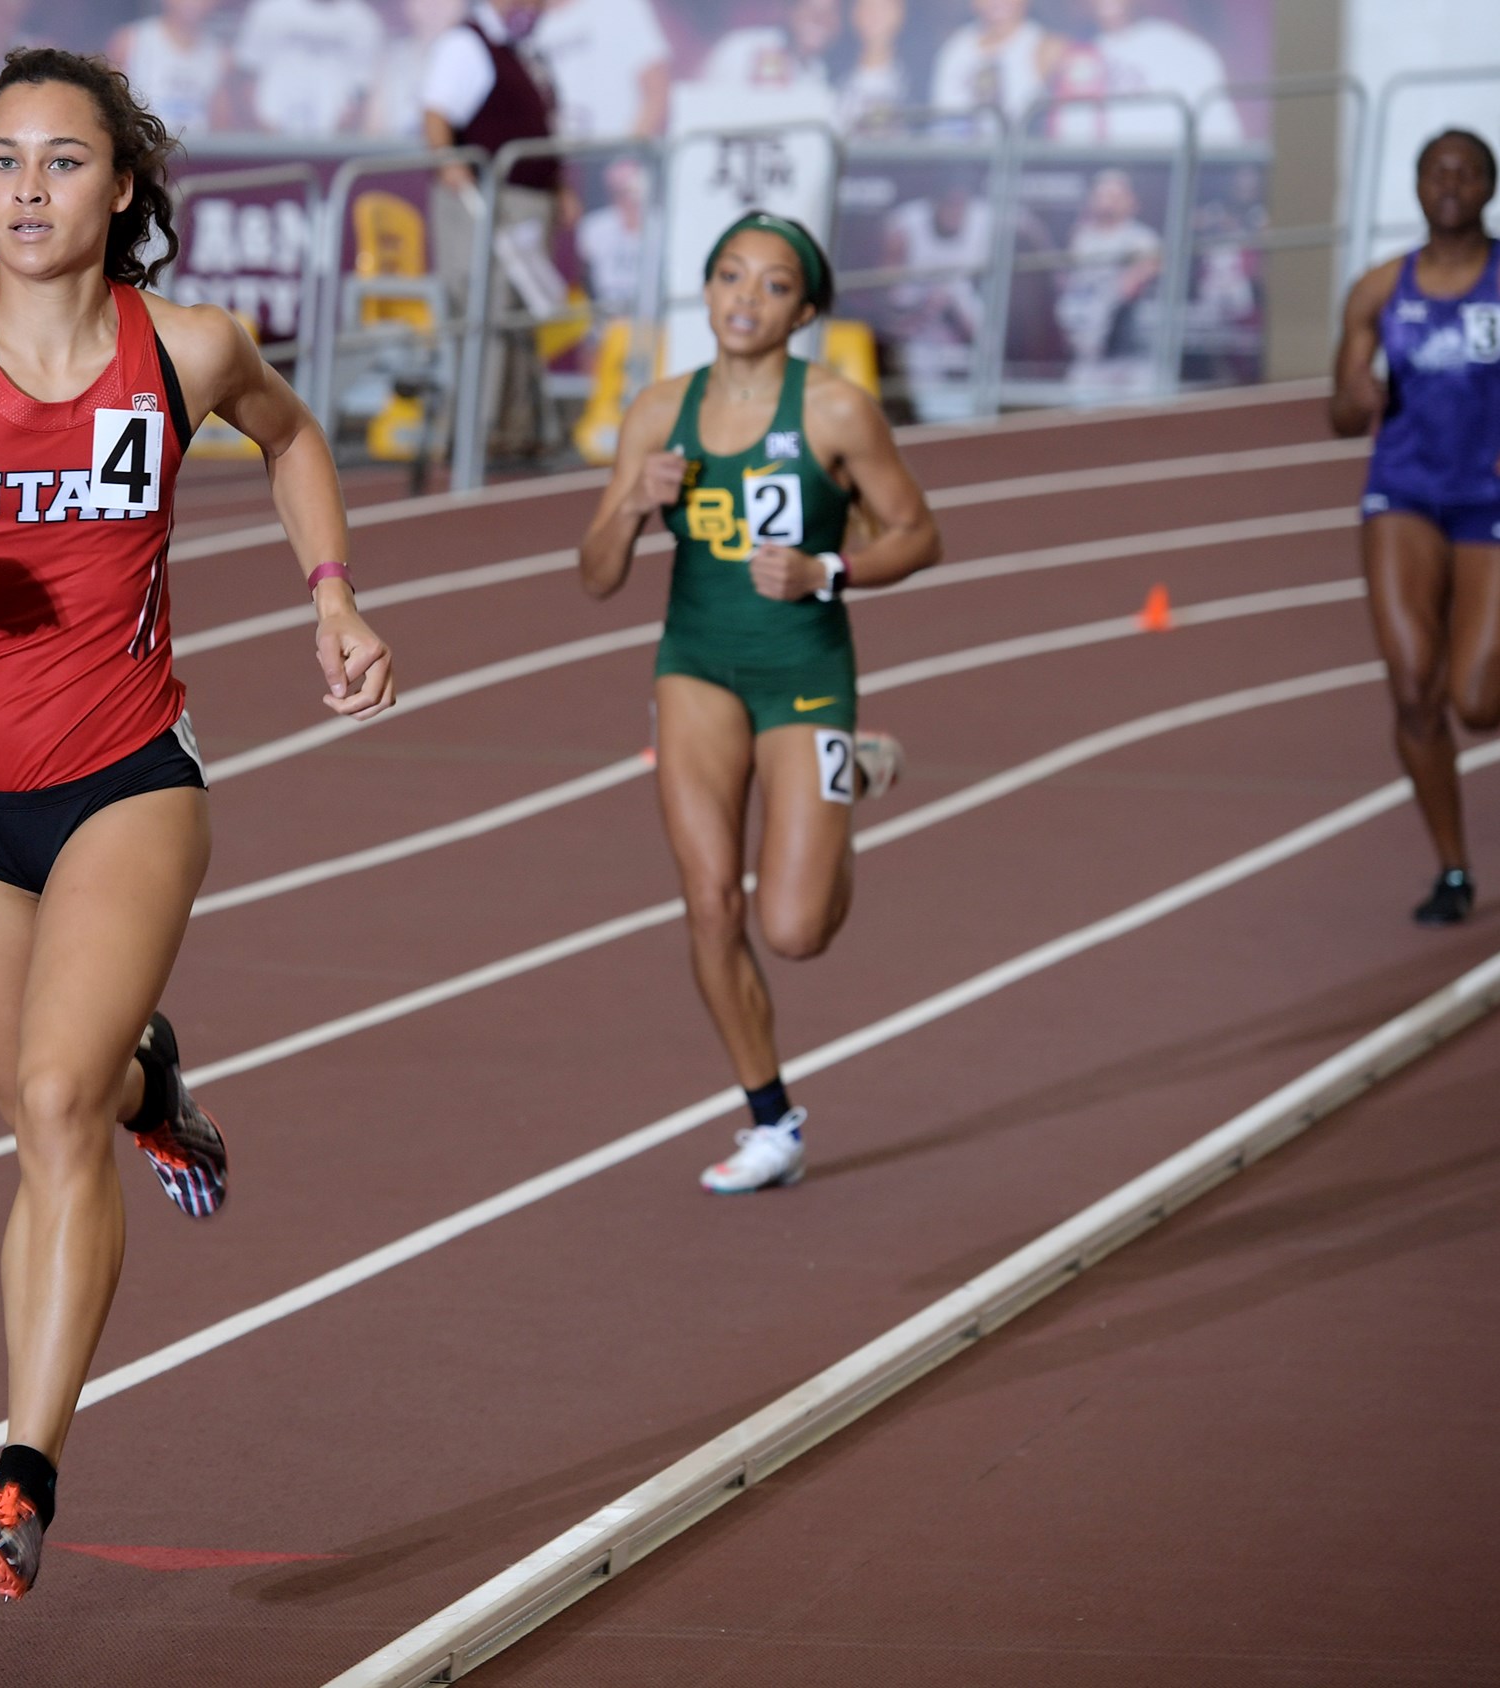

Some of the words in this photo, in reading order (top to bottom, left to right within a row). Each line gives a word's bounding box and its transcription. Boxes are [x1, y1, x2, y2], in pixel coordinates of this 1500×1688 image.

[100, 417, 151, 503] 4
[755, 484, 790, 537] 2
[826, 738, 851, 795] 2
